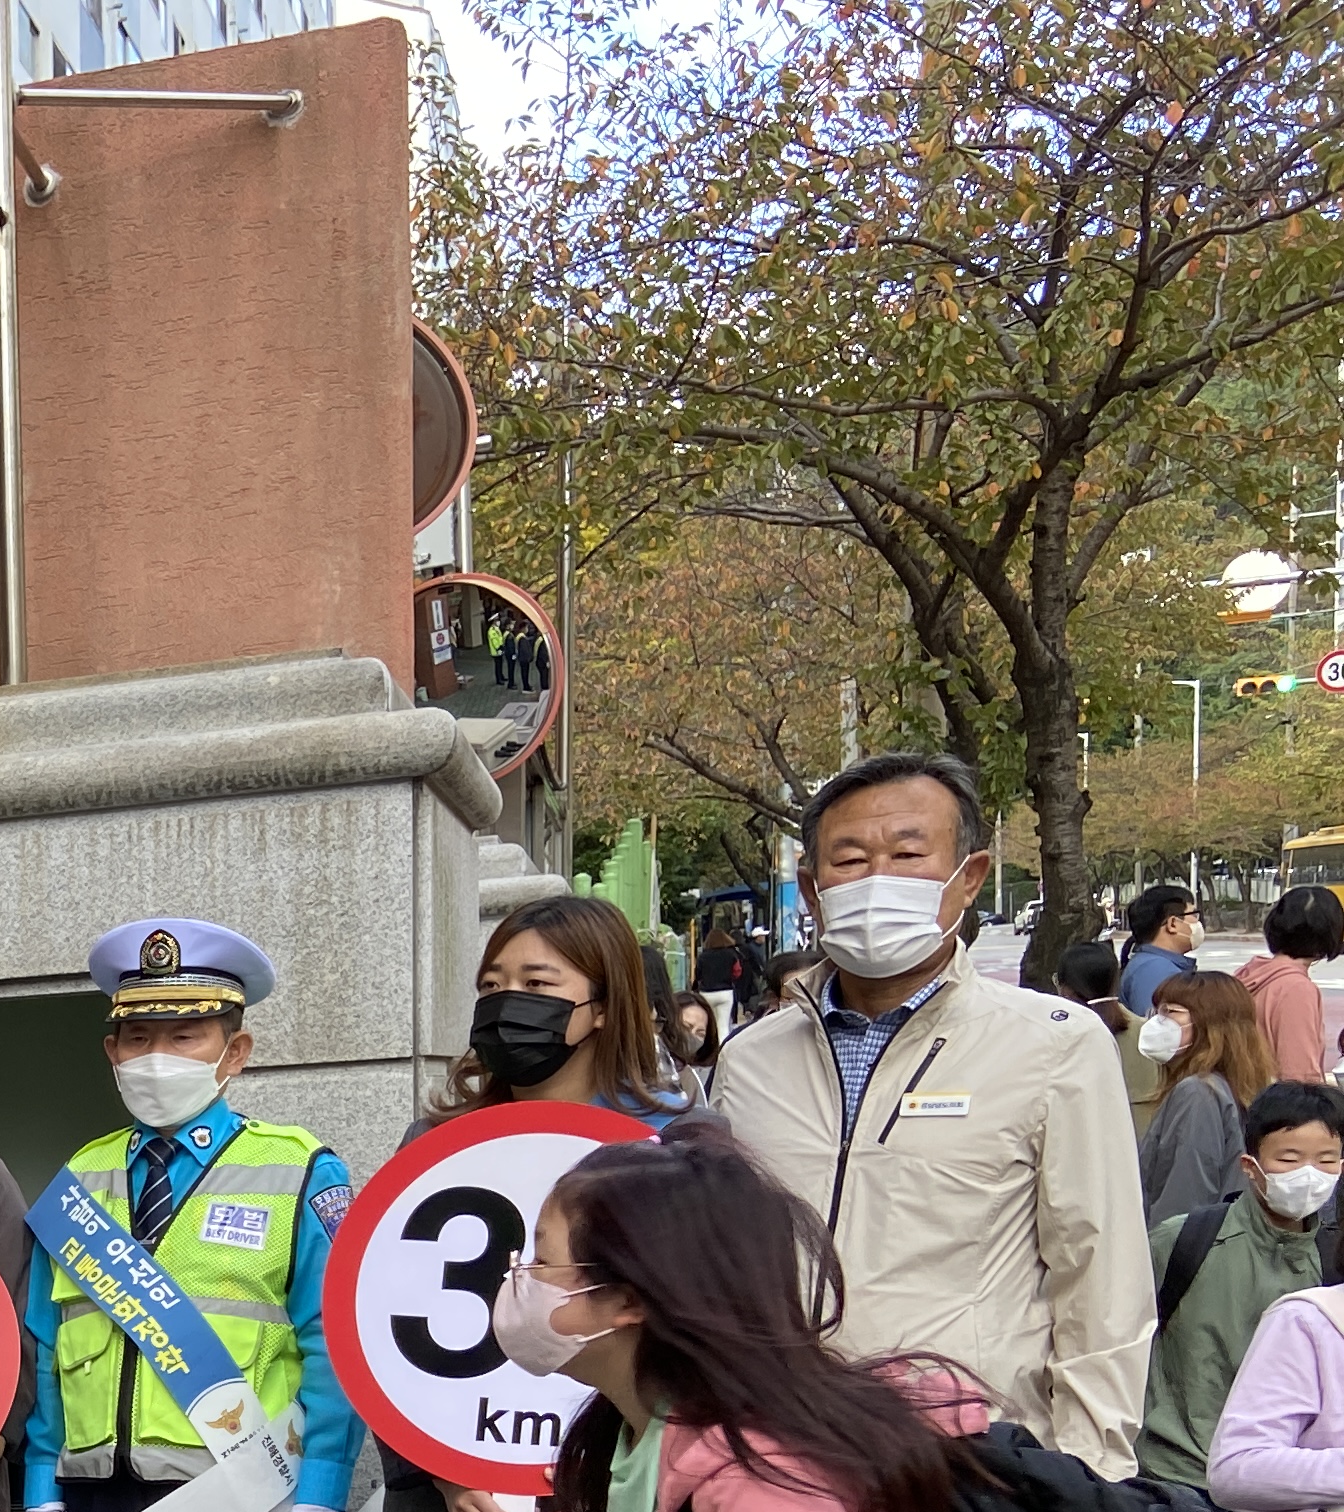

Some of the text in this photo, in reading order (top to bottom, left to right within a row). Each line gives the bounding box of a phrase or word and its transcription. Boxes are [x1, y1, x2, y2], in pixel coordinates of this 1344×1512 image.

[1328, 662, 1344, 682] 3
[60, 1184, 181, 1310] 사람이 우선인
[205, 1227, 261, 1246] BEST DRIVER
[475, 1397, 561, 1447] km
